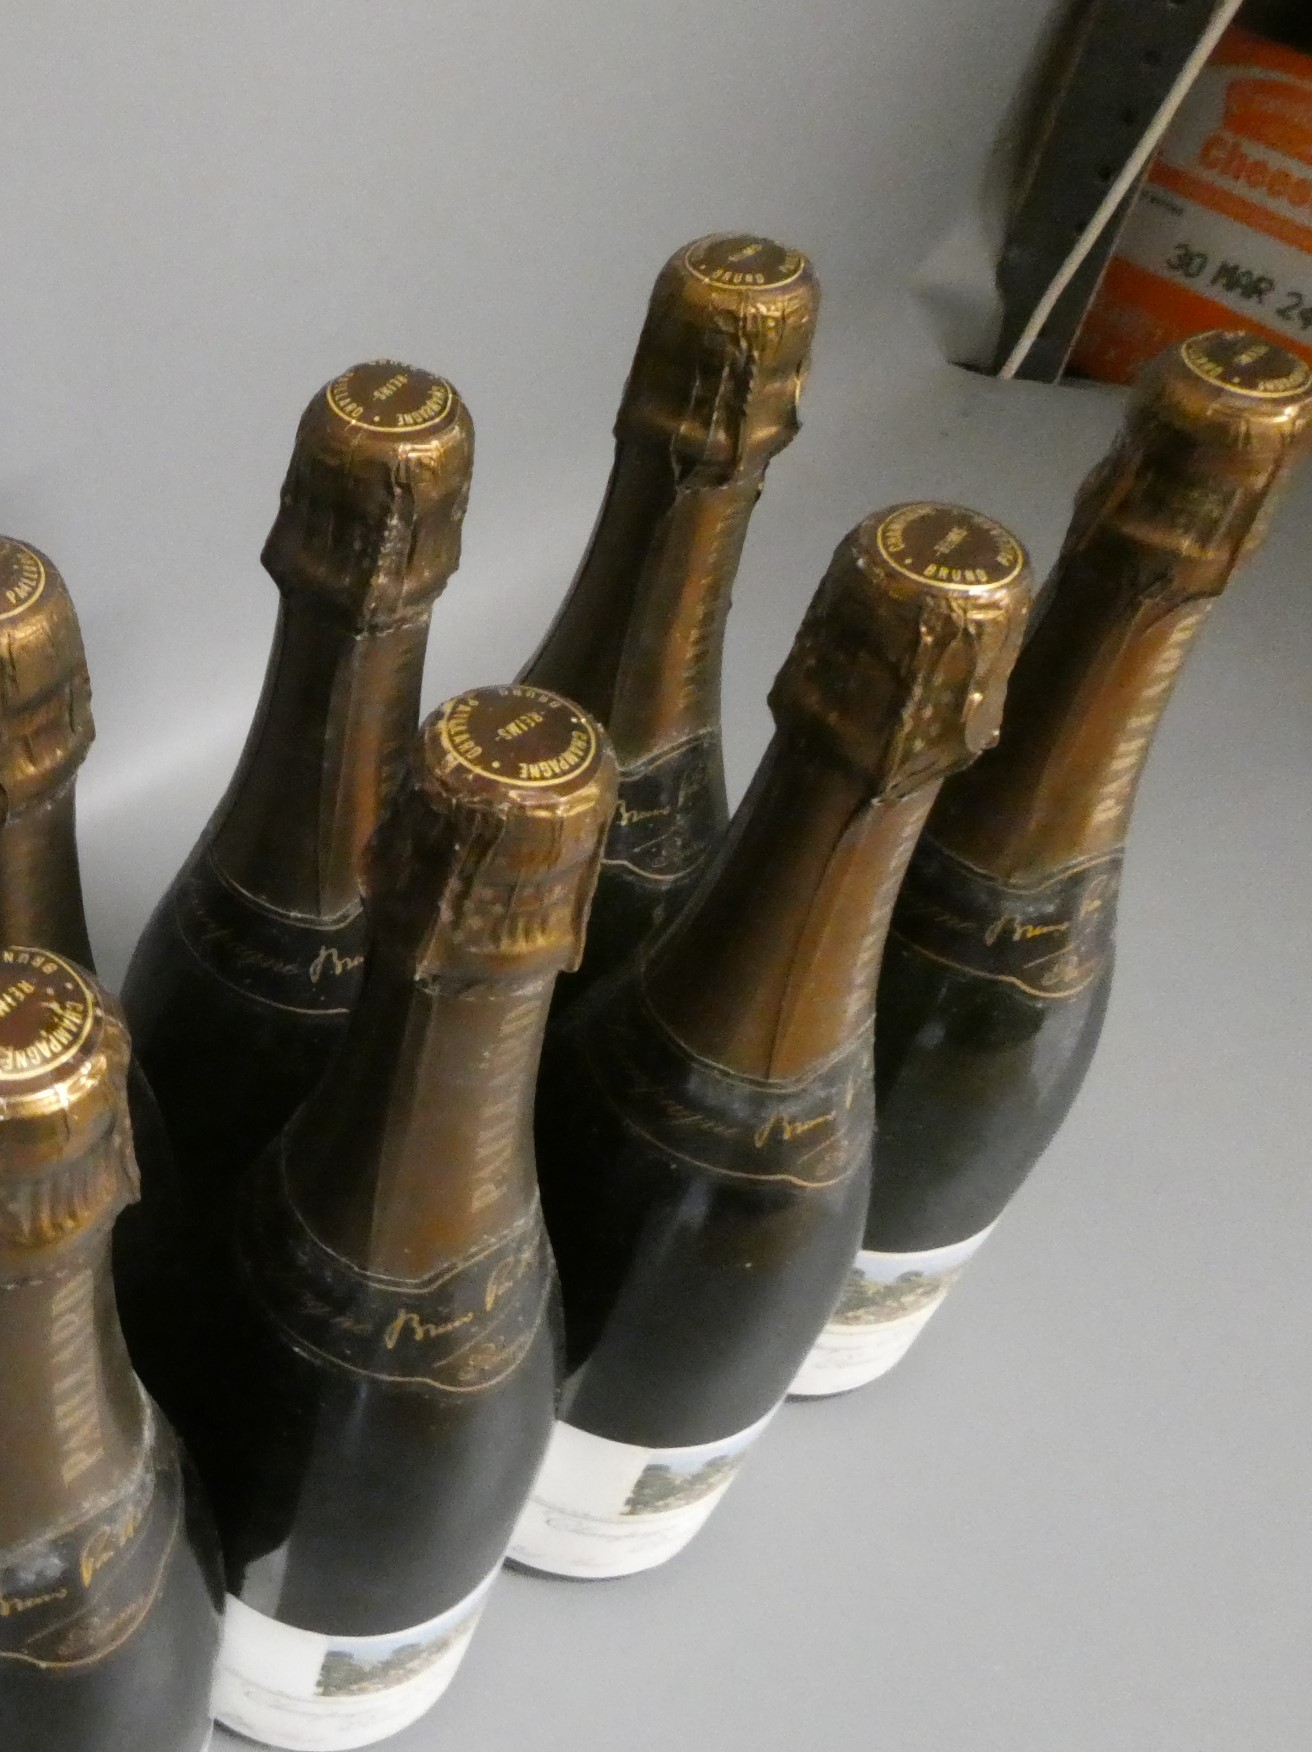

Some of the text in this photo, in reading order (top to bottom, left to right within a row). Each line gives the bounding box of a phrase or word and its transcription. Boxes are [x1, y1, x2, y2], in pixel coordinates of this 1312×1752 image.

[1167, 243, 1208, 279] 30
[1210, 260, 1276, 303] MAR
[519, 730, 588, 780] CHAMPAGNE
